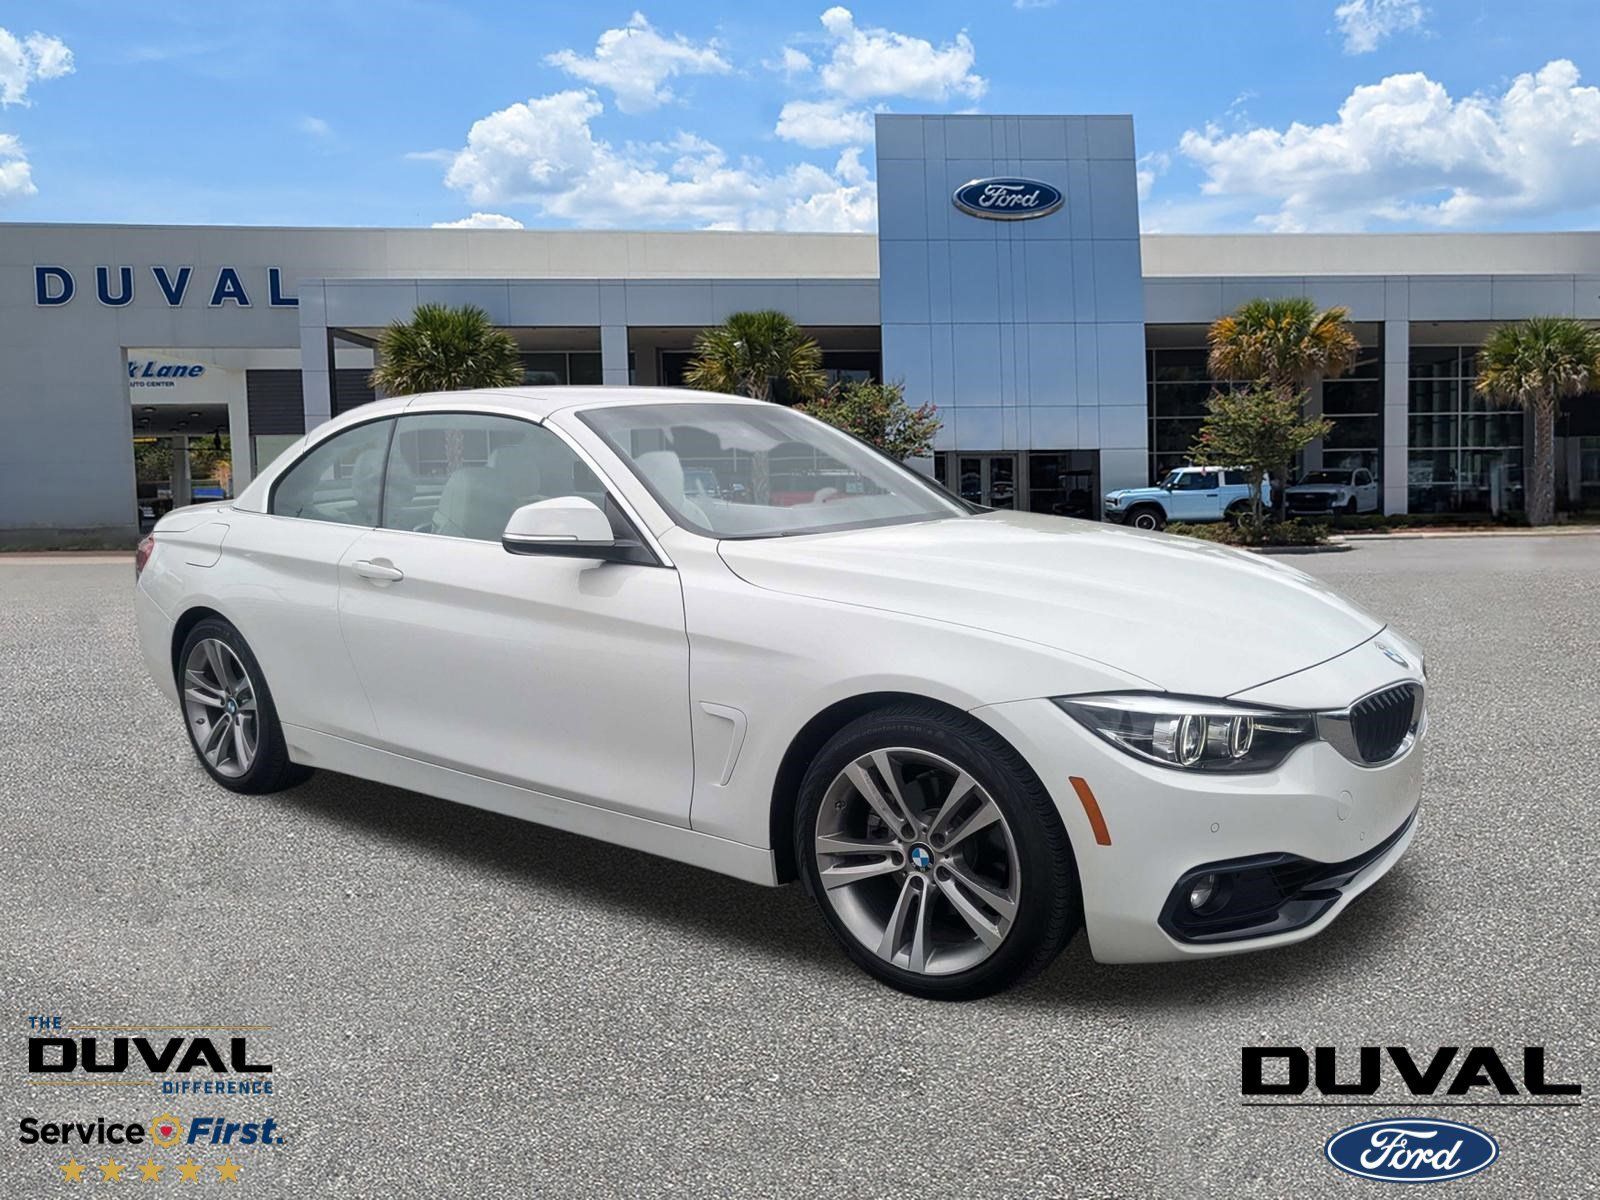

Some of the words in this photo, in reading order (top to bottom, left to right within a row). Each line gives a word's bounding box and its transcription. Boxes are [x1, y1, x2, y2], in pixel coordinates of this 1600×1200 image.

[979, 184, 1040, 207] Ford
[34, 265, 299, 307] DUVAL
[142, 361, 205, 378] Lane
